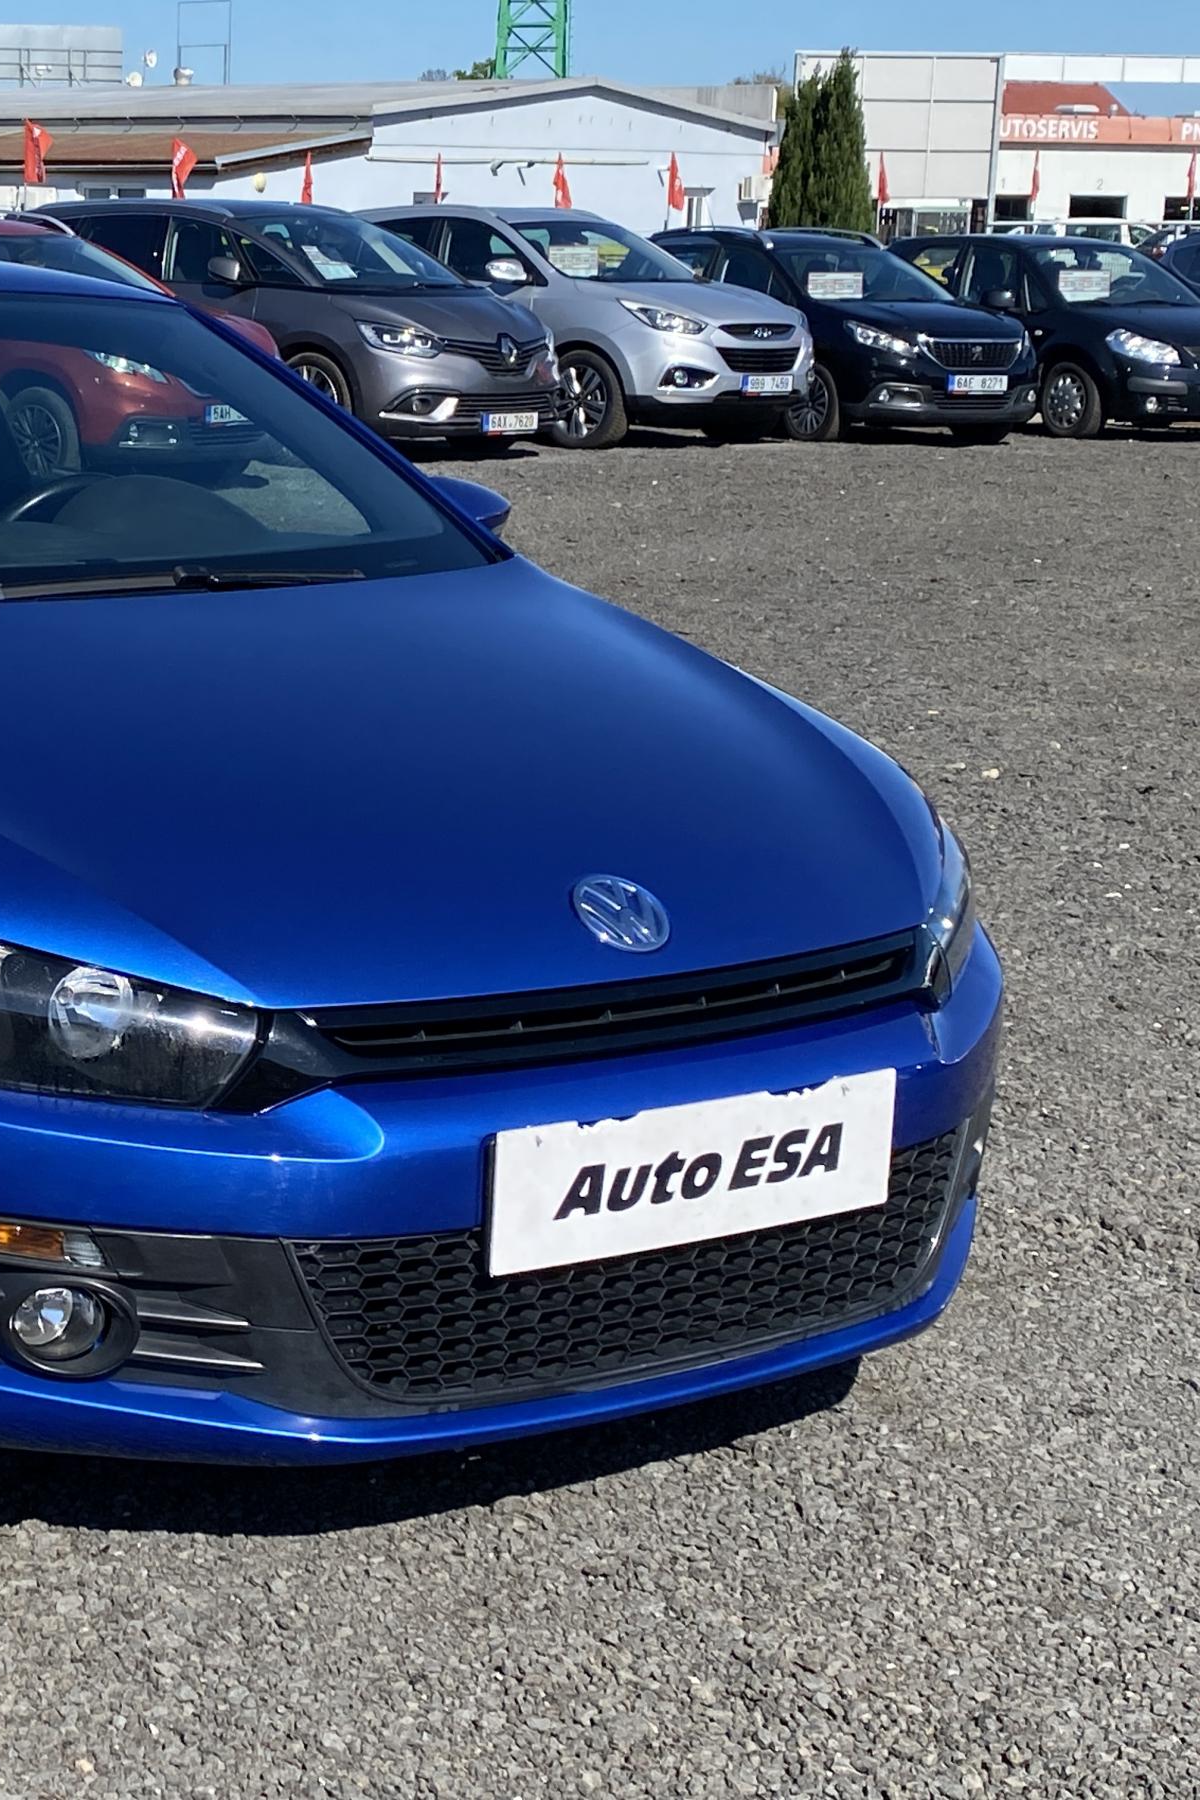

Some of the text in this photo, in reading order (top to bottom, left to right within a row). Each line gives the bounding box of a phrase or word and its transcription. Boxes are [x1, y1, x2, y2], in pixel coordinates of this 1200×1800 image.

[1096, 178, 1104, 190] 2
[553, 1122, 844, 1220] Auto ESA
